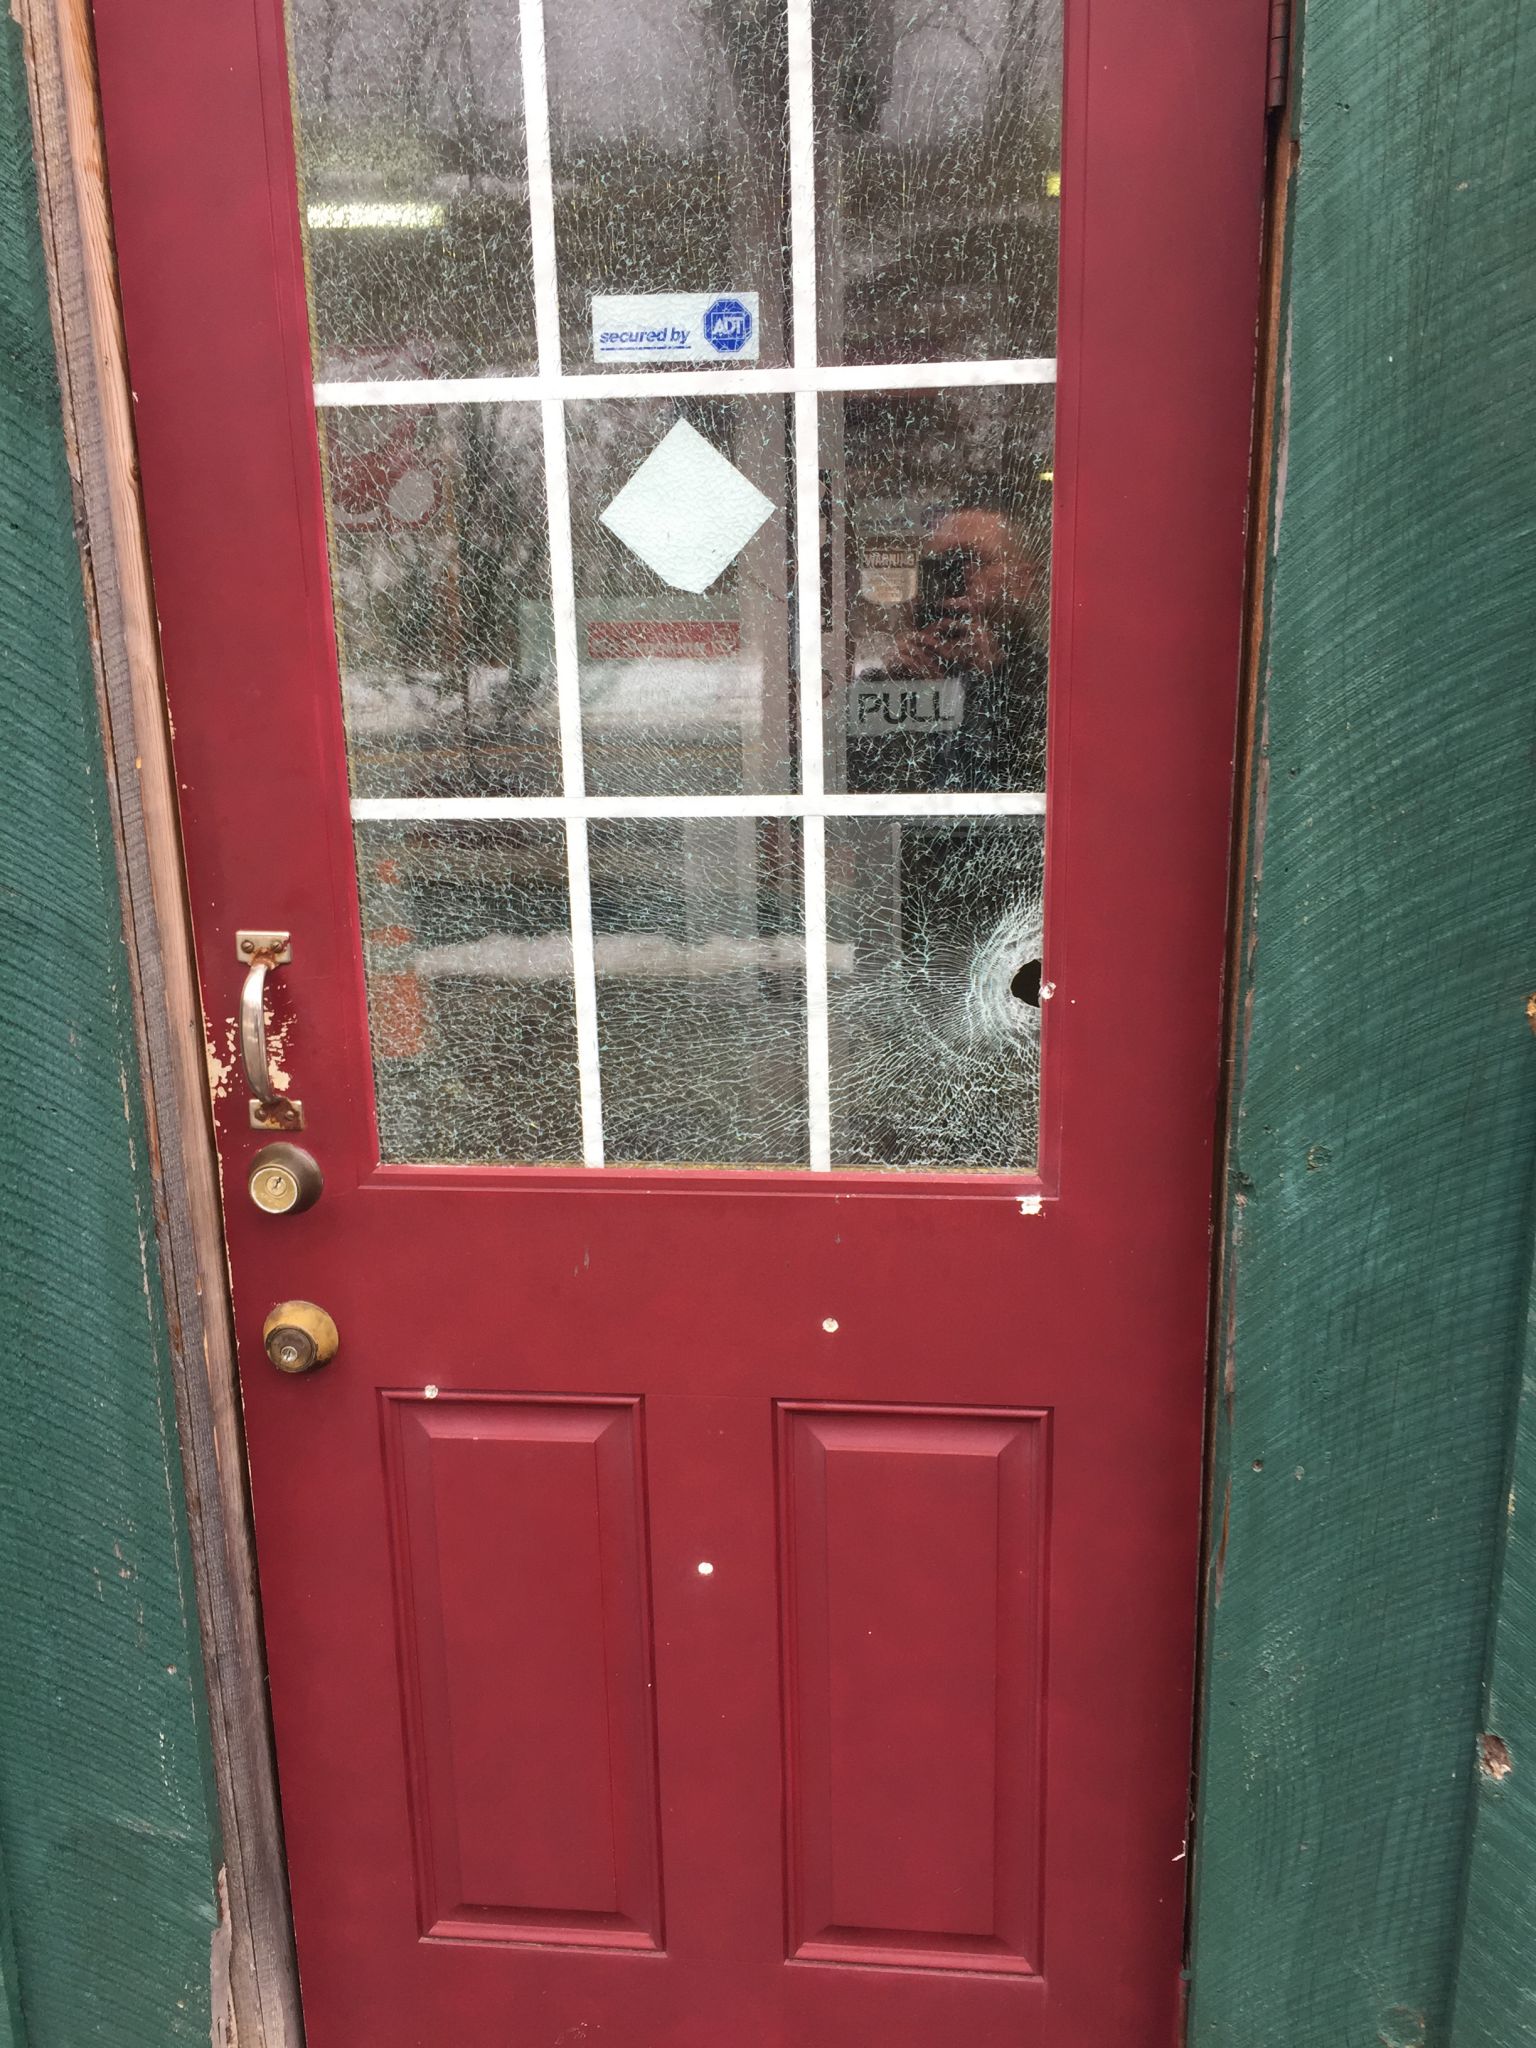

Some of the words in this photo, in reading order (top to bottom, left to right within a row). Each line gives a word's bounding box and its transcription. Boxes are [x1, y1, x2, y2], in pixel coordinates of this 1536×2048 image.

[712, 316, 745, 335] ADT
[600, 327, 667, 344] secured
[670, 327, 691, 345] by
[858, 691, 954, 724] PULL
